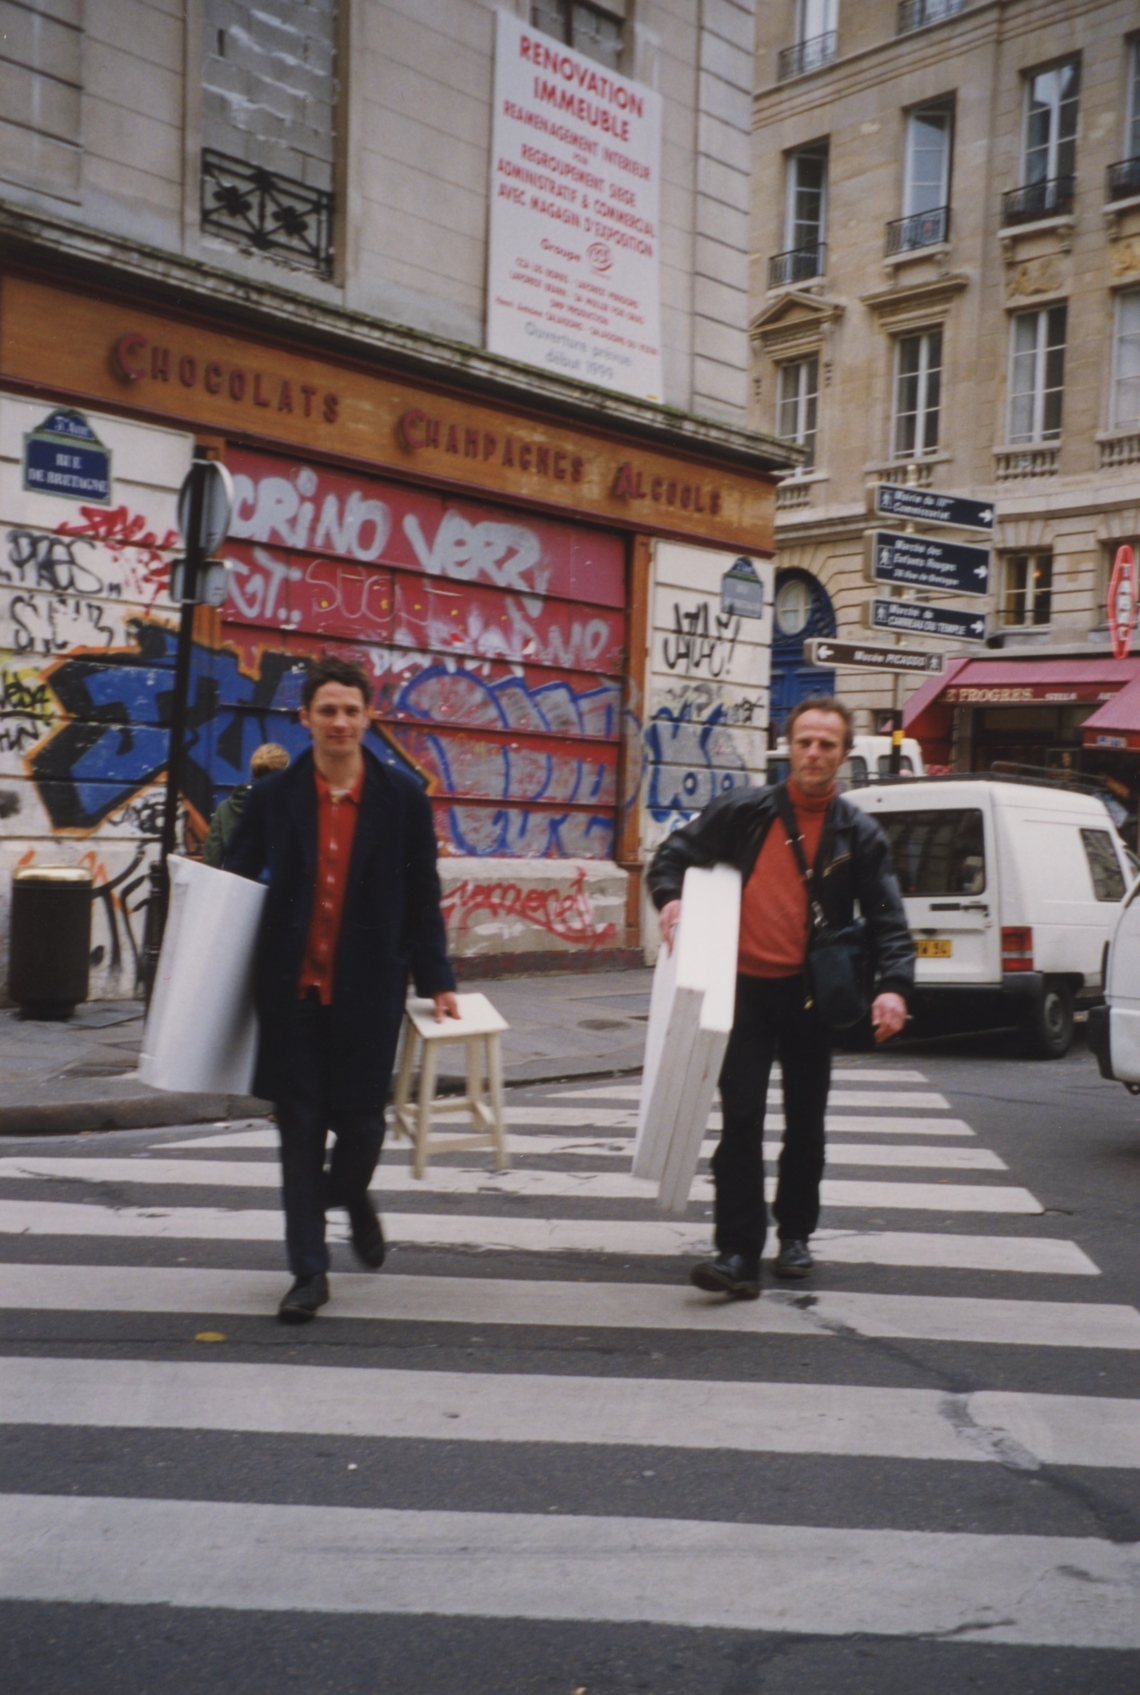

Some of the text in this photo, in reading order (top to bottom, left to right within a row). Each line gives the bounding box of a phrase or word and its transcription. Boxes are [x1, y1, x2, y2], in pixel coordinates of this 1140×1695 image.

[519, 34, 644, 118] RENOVATION
[533, 76, 630, 142] IMMEUBLE
[521, 143, 606, 193] REGROUPEMENT
[602, 146, 651, 181] INTERIEUR
[497, 157, 656, 238] ADMINISTRATIF & COMMERCIAL
[498, 183, 526, 207] AVEC
[530, 195, 580, 228] MAGASIN
[540, 238, 582, 262] Groupe
[27, 468, 109, 493] DE BRETAGNE
[55, 453, 82, 470] RUE
